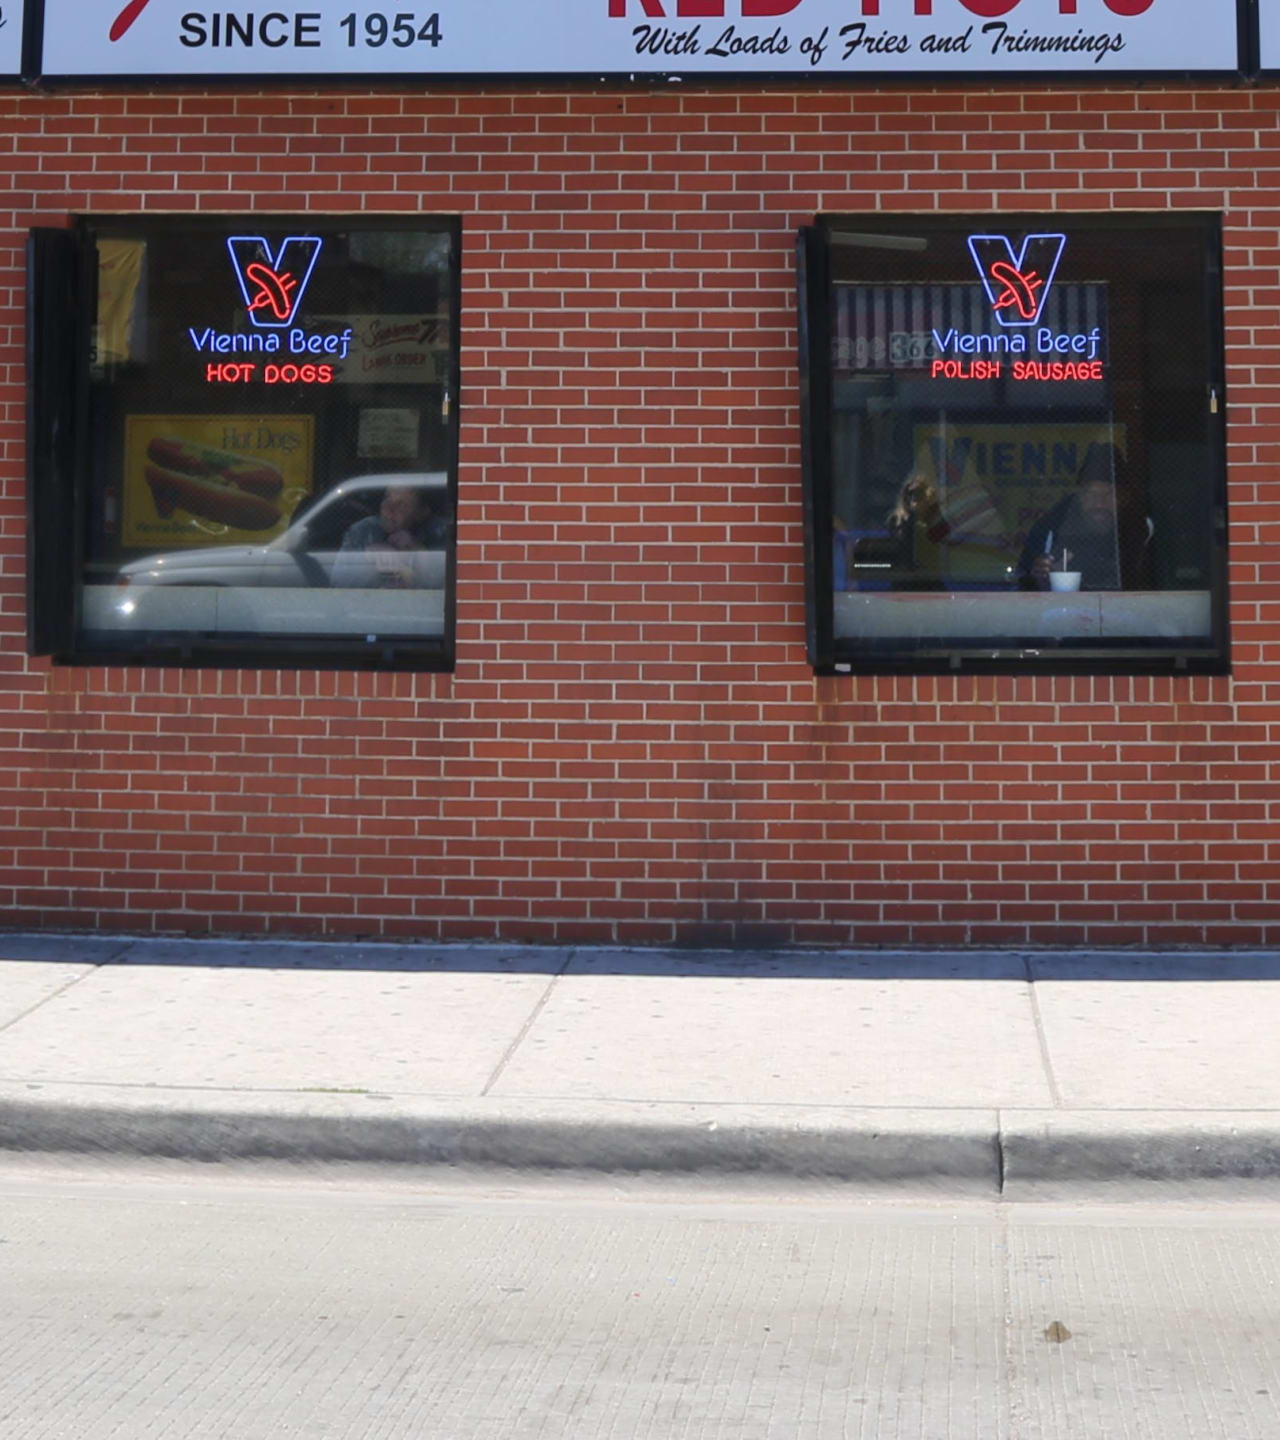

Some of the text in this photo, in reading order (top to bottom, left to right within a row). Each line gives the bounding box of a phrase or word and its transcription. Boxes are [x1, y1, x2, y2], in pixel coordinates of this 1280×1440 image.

[178, 12, 444, 48] SINCE 1954
[631, 20, 1126, 66] With Loads of Fries and Trimmings
[189, 327, 280, 354] Vienna
[289, 328, 352, 359] Beef
[931, 327, 1101, 360] Vienna Beef
[206, 363, 334, 384] HOT DOGS
[931, 360, 1104, 381] POLISH SAUSAGE
[222, 425, 301, 455] Hot Dogs
[929, 436, 1084, 487] VIENN
